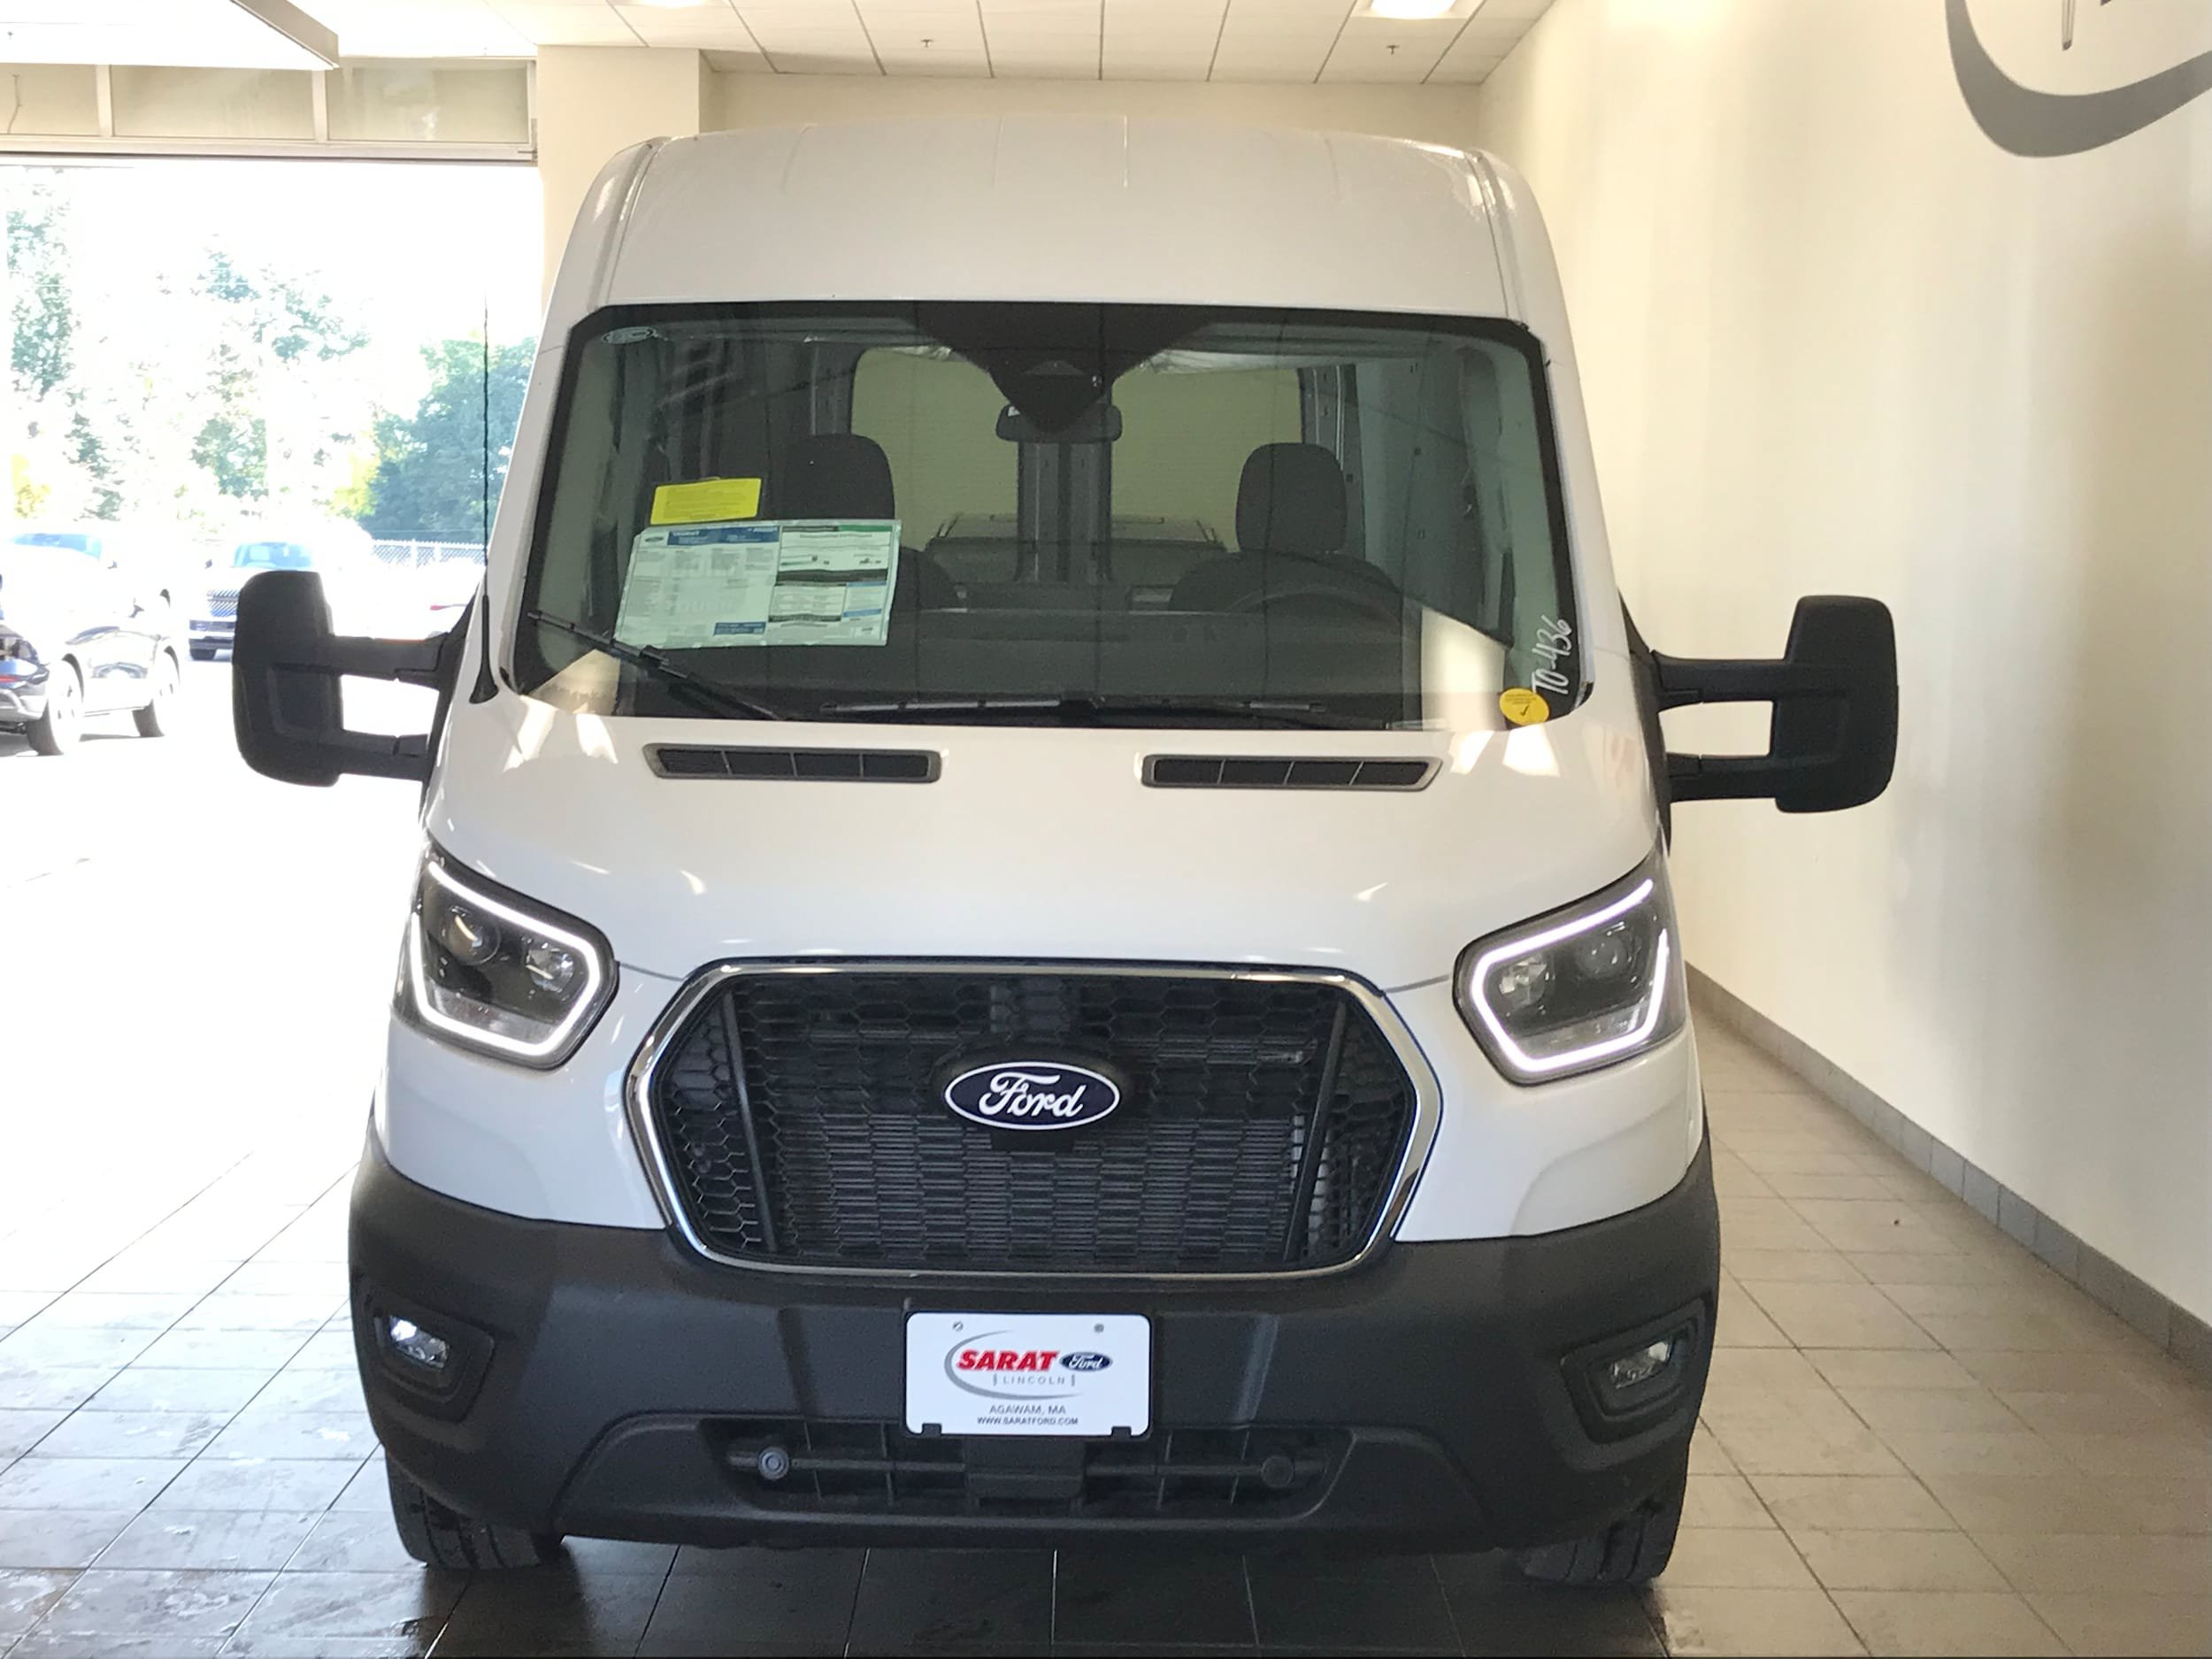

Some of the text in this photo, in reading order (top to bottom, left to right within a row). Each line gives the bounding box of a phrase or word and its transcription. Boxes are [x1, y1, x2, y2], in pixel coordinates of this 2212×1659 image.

[979, 1071, 1087, 1118] Ford
[957, 1349, 1059, 1371] SARAT
[1002, 1376, 1066, 1386] LINCOLN
[989, 1404, 1067, 1415] AGAWAM, MA
[977, 1417, 1079, 1425] WWW.SARATFORD.COM
